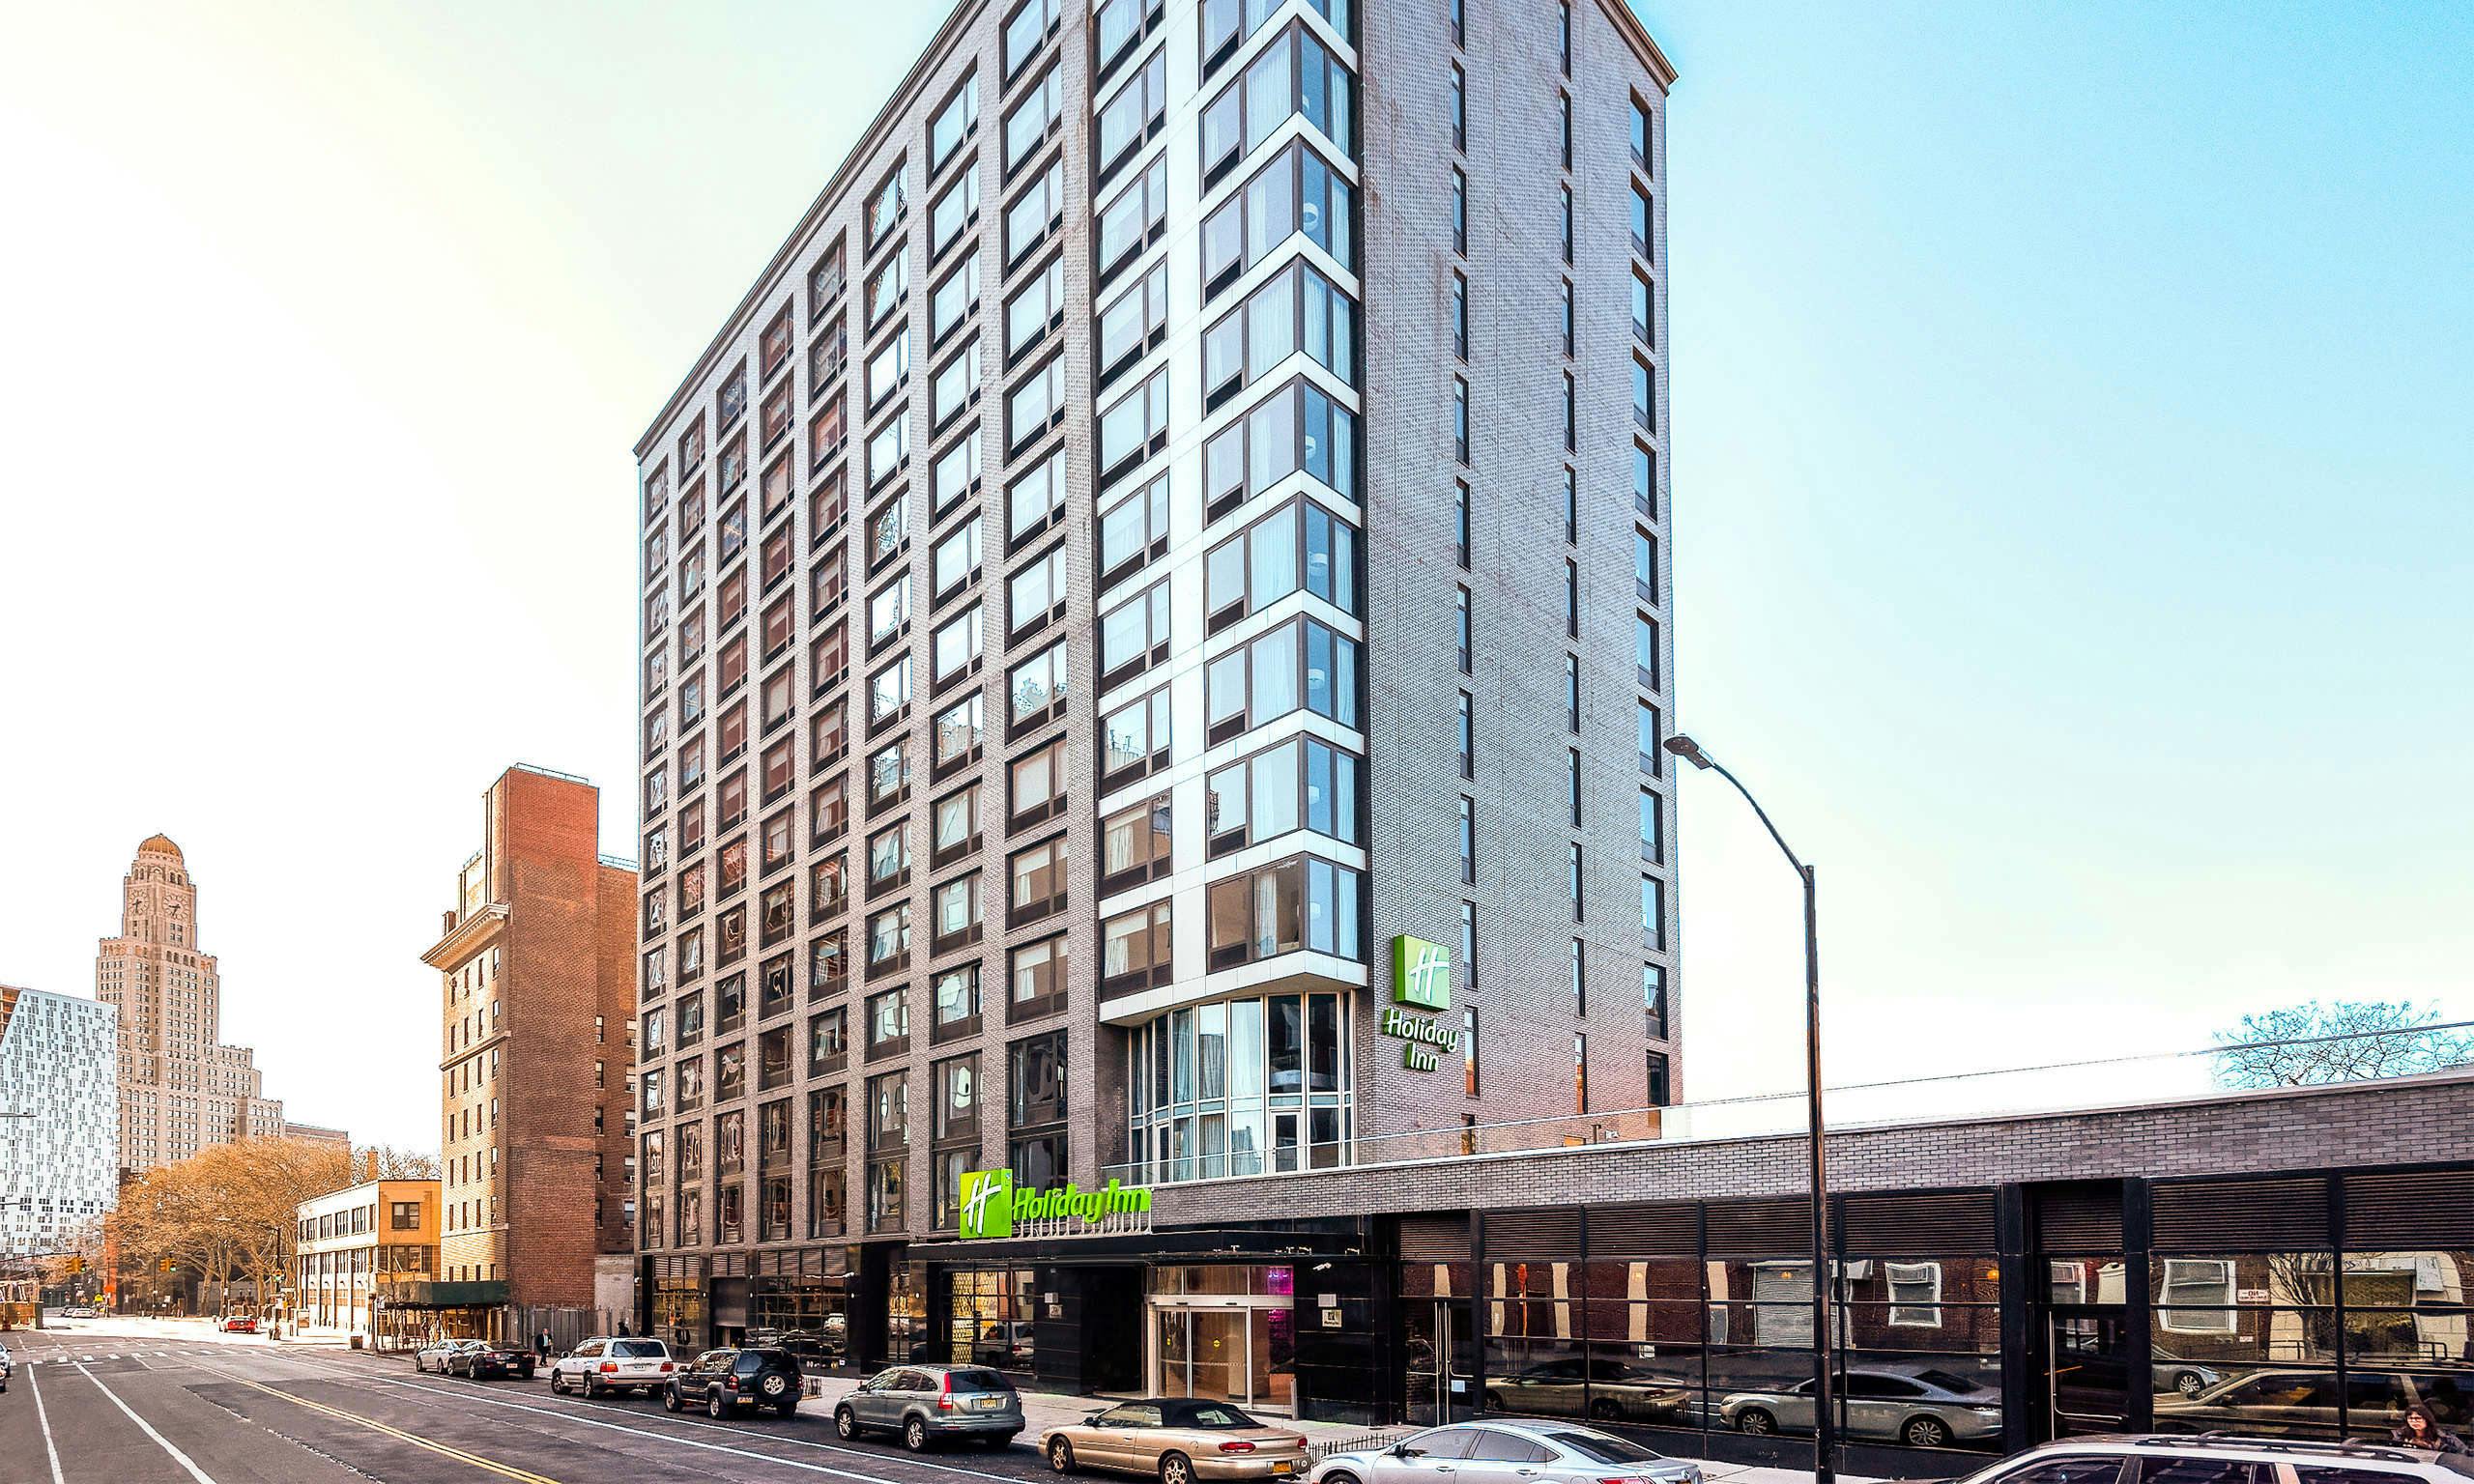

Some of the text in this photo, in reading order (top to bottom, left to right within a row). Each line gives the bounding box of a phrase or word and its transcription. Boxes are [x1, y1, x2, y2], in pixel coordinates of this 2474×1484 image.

[1383, 1007, 1459, 1053] Holiday
[1406, 1042, 1439, 1071] Inn
[1012, 1179, 1152, 1223] Holiday Inn
